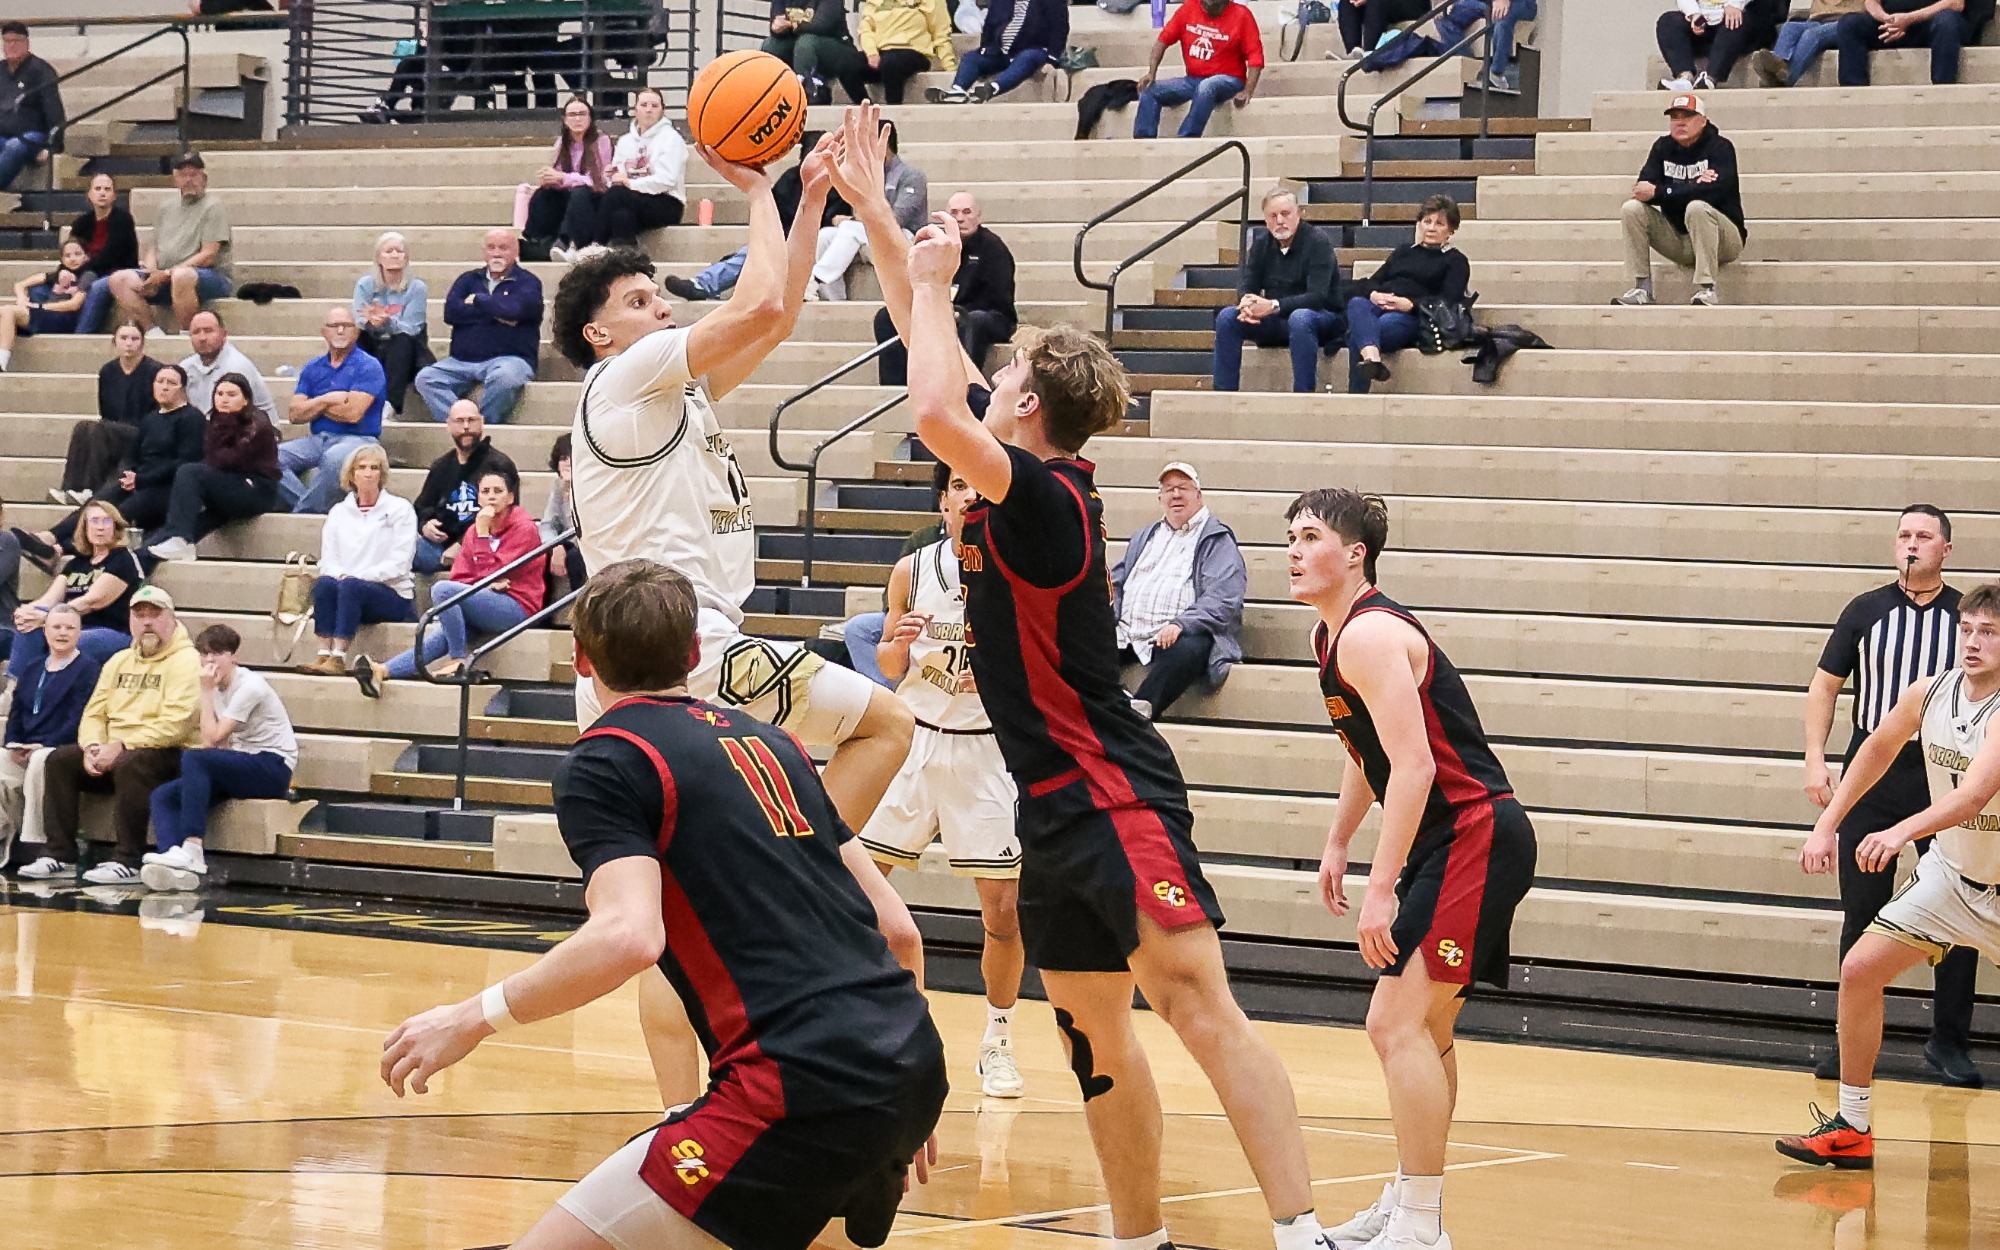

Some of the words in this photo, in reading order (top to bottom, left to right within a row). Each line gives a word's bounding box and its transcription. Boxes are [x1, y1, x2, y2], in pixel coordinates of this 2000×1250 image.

[1189, 44, 1214, 60] MIT
[748, 96, 793, 146] NCAA
[717, 736, 815, 837] 11
[1153, 881, 1186, 907] SC
[1437, 939, 1464, 967] SC
[671, 1139, 710, 1185] SC
